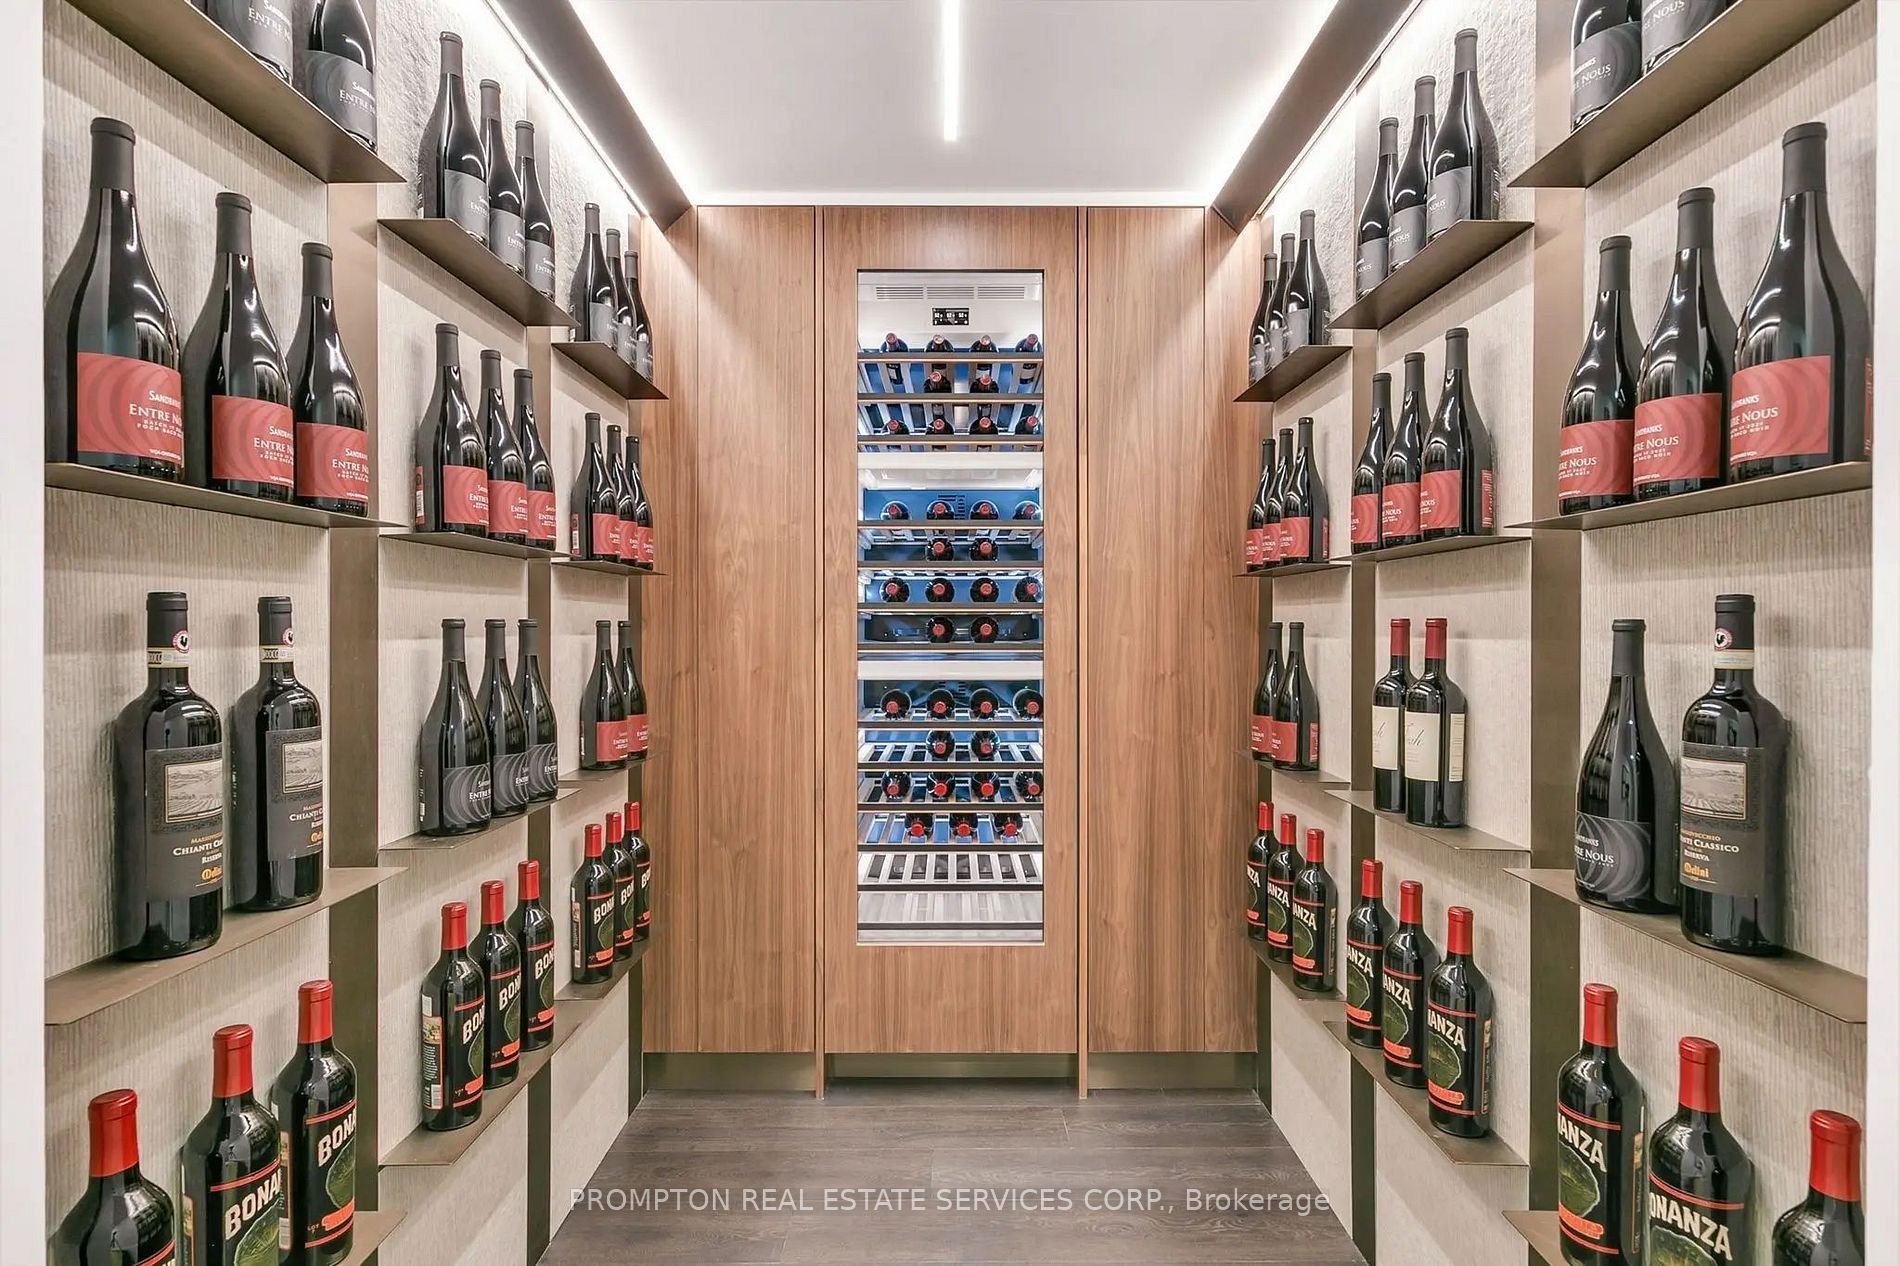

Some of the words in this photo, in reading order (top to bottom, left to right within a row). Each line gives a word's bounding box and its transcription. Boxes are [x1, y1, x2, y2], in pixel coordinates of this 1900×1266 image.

[1581, 63, 1612, 83] NOUS
[129, 403, 171, 422] ENTRE
[1741, 407, 1779, 423] NOUS
[253, 437, 287, 454] ENTRE
[1646, 436, 1680, 450] NOUS
[332, 459, 361, 473] ENTRE
[1569, 456, 1597, 468] NOUS
[172, 842, 213, 856] CHIANTI
[1693, 839, 1740, 853] CLASSICO
[1585, 849, 1614, 864] NOUS
